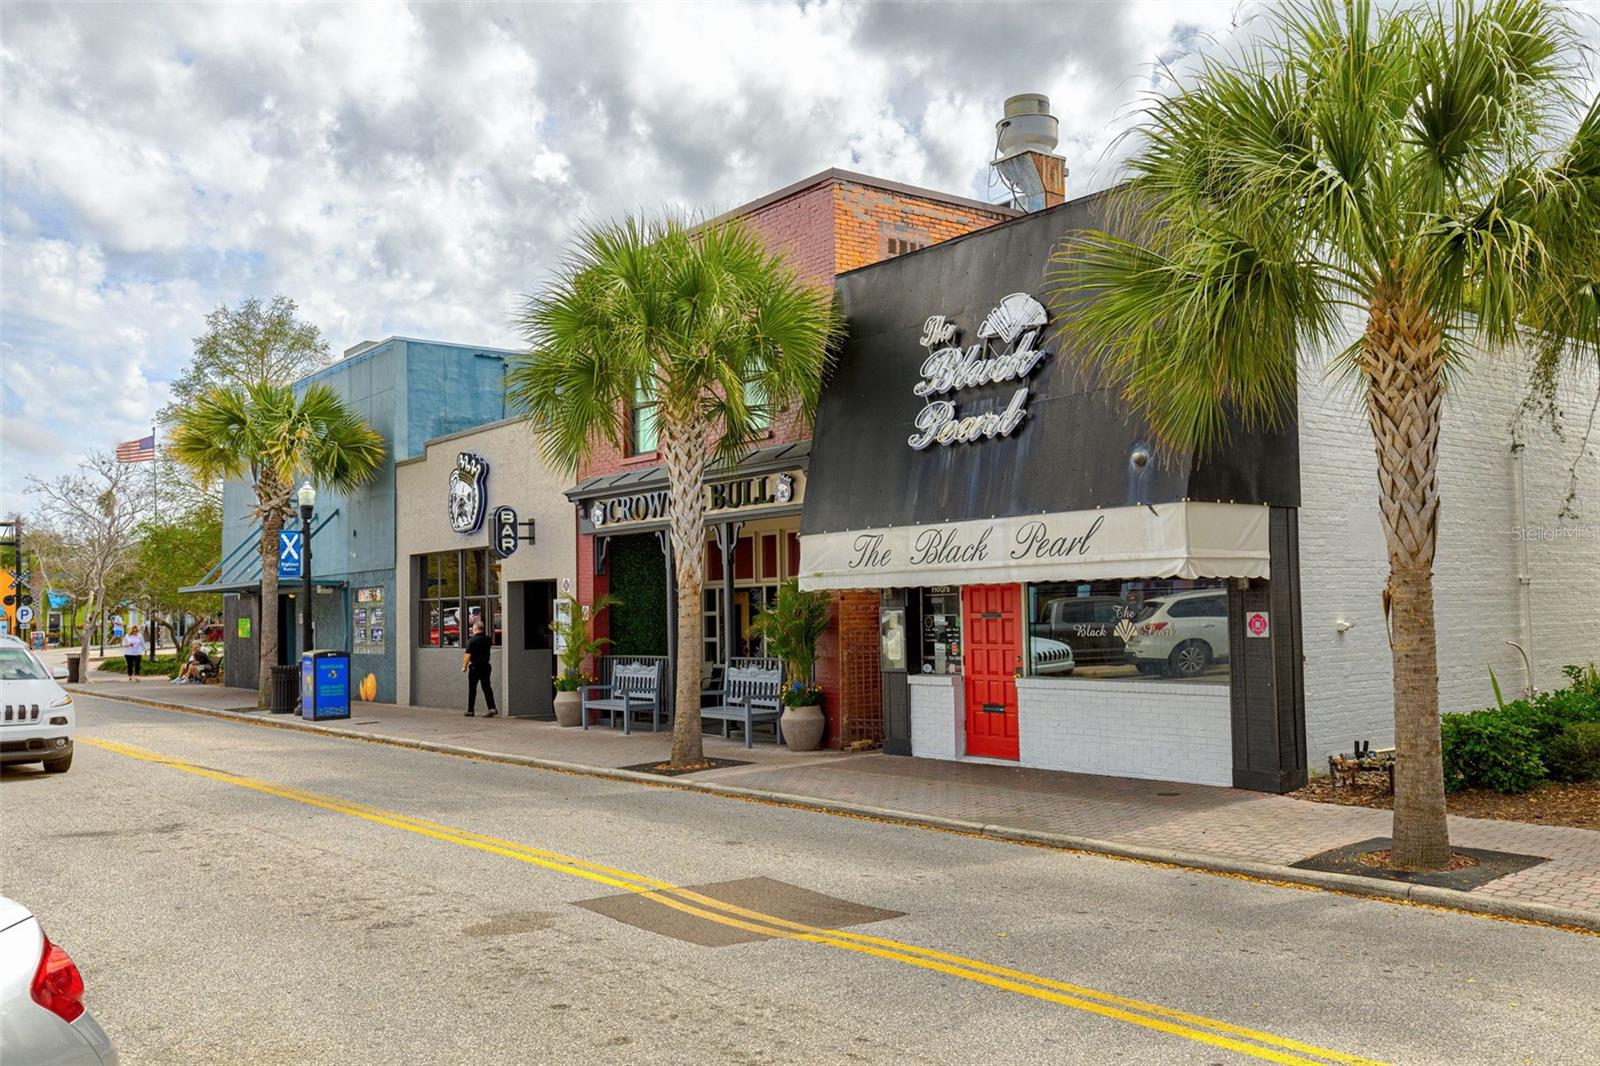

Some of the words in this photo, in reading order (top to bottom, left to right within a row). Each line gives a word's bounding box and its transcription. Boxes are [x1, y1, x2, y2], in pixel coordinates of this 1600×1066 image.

[920, 315, 958, 346] The
[913, 330, 1046, 397] Black
[908, 387, 1028, 450] Pearl
[709, 476, 776, 511] BULL
[500, 510, 515, 551] BAR
[848, 533, 892, 569] The
[909, 526, 994, 565] Black
[1010, 515, 1105, 560] Pearl
[20, 609, 29, 620] P
[1112, 605, 1137, 619] The
[1072, 623, 1108, 637] Black
